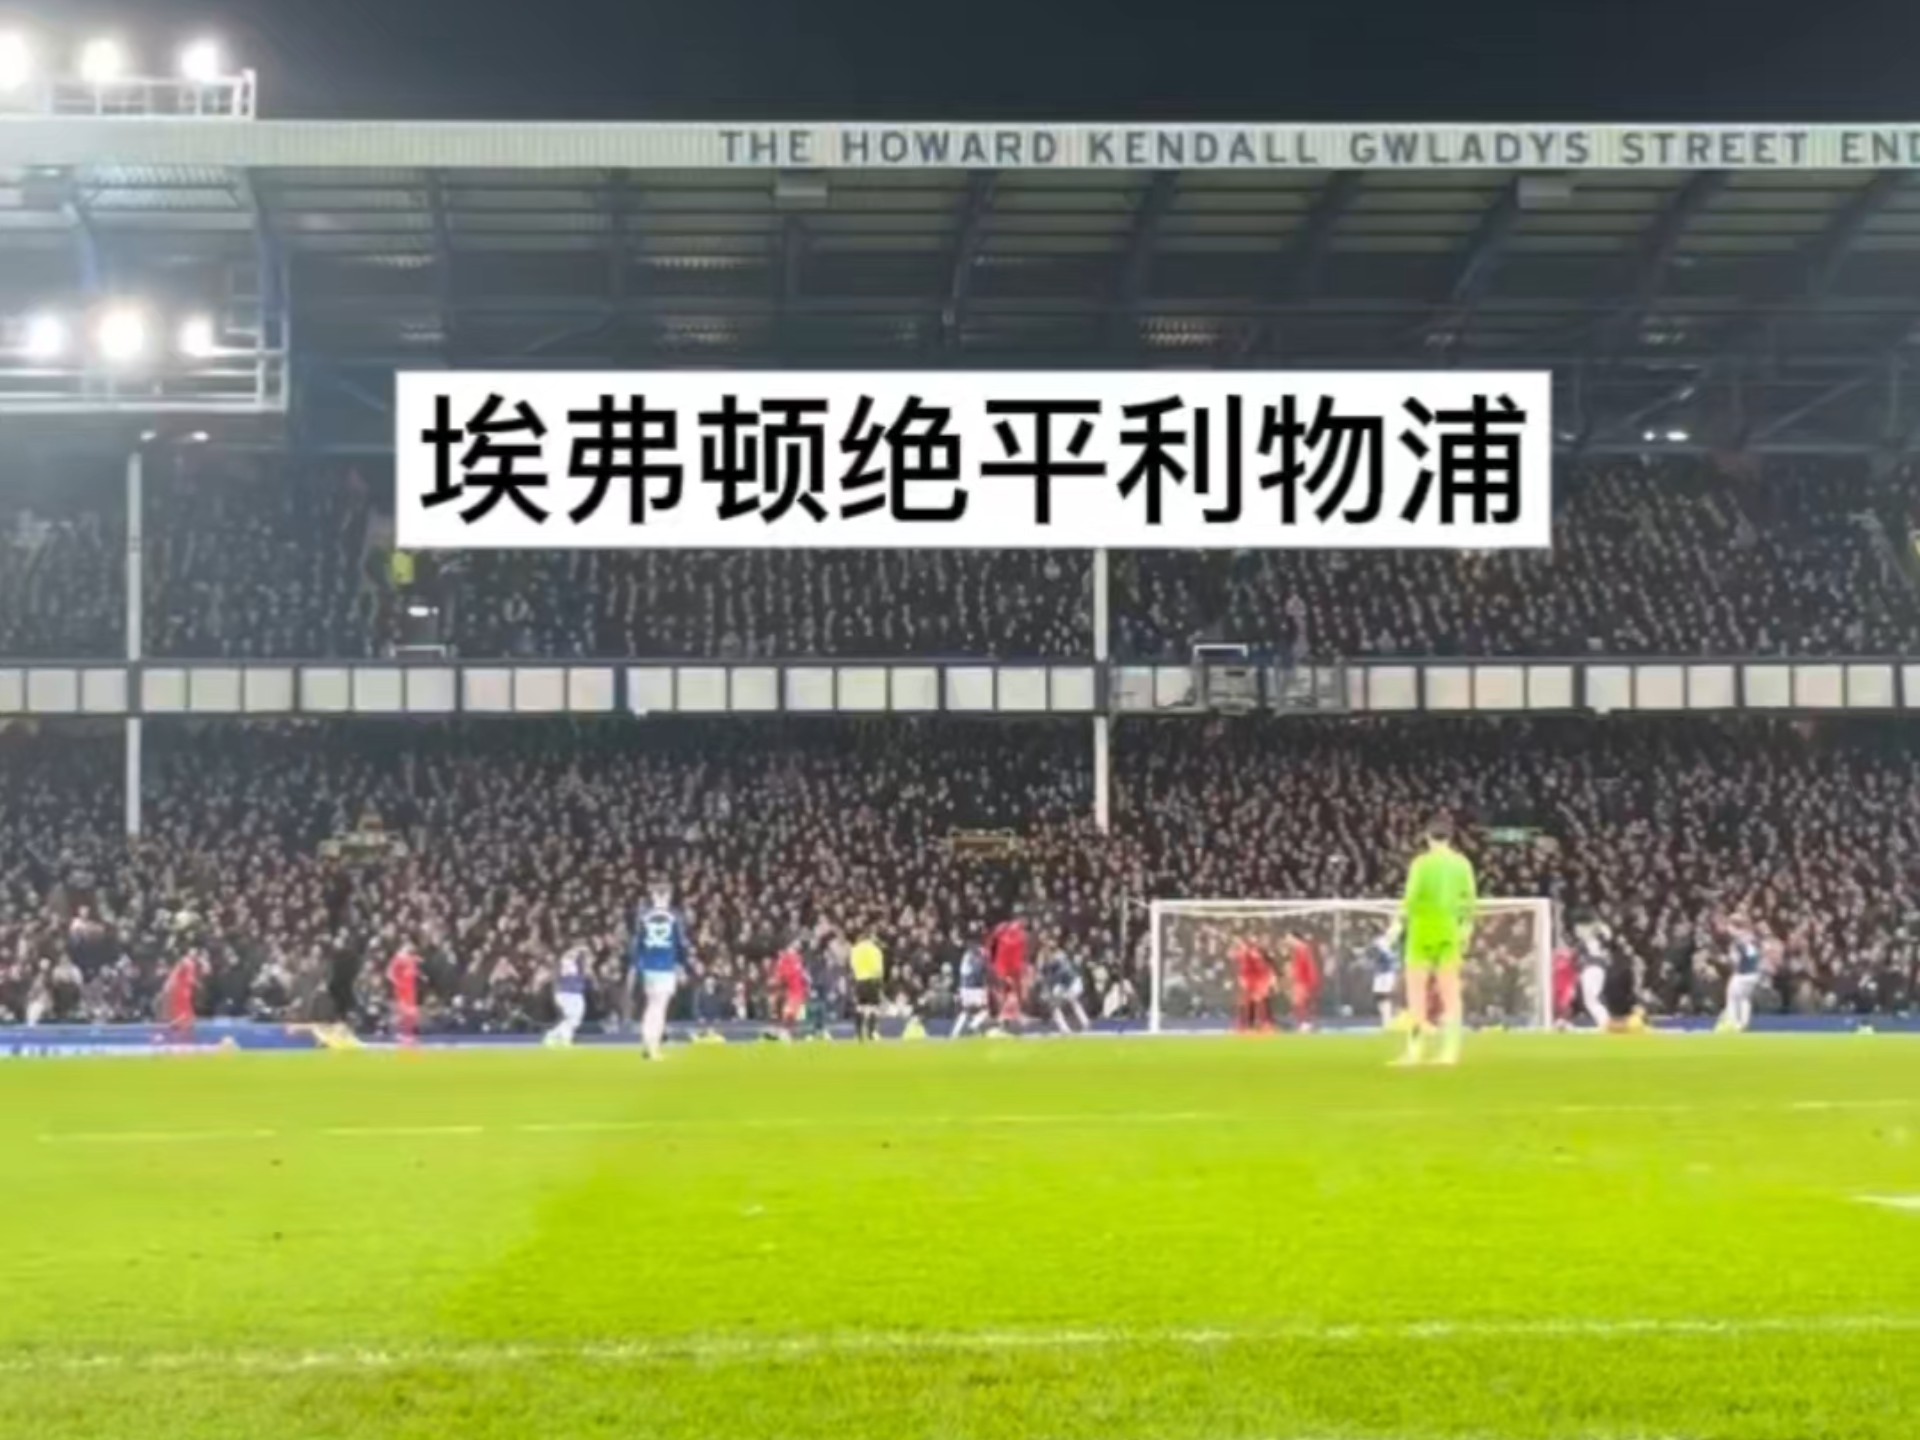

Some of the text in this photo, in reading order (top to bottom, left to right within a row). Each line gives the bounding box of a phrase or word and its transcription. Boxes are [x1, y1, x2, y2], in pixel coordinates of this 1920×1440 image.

[718, 130, 810, 162] THE
[841, 131, 1057, 163] HOWARD
[1088, 131, 1317, 163] KENDALL
[1349, 132, 1589, 163] GWLADYS
[1622, 132, 1807, 163] STREET
